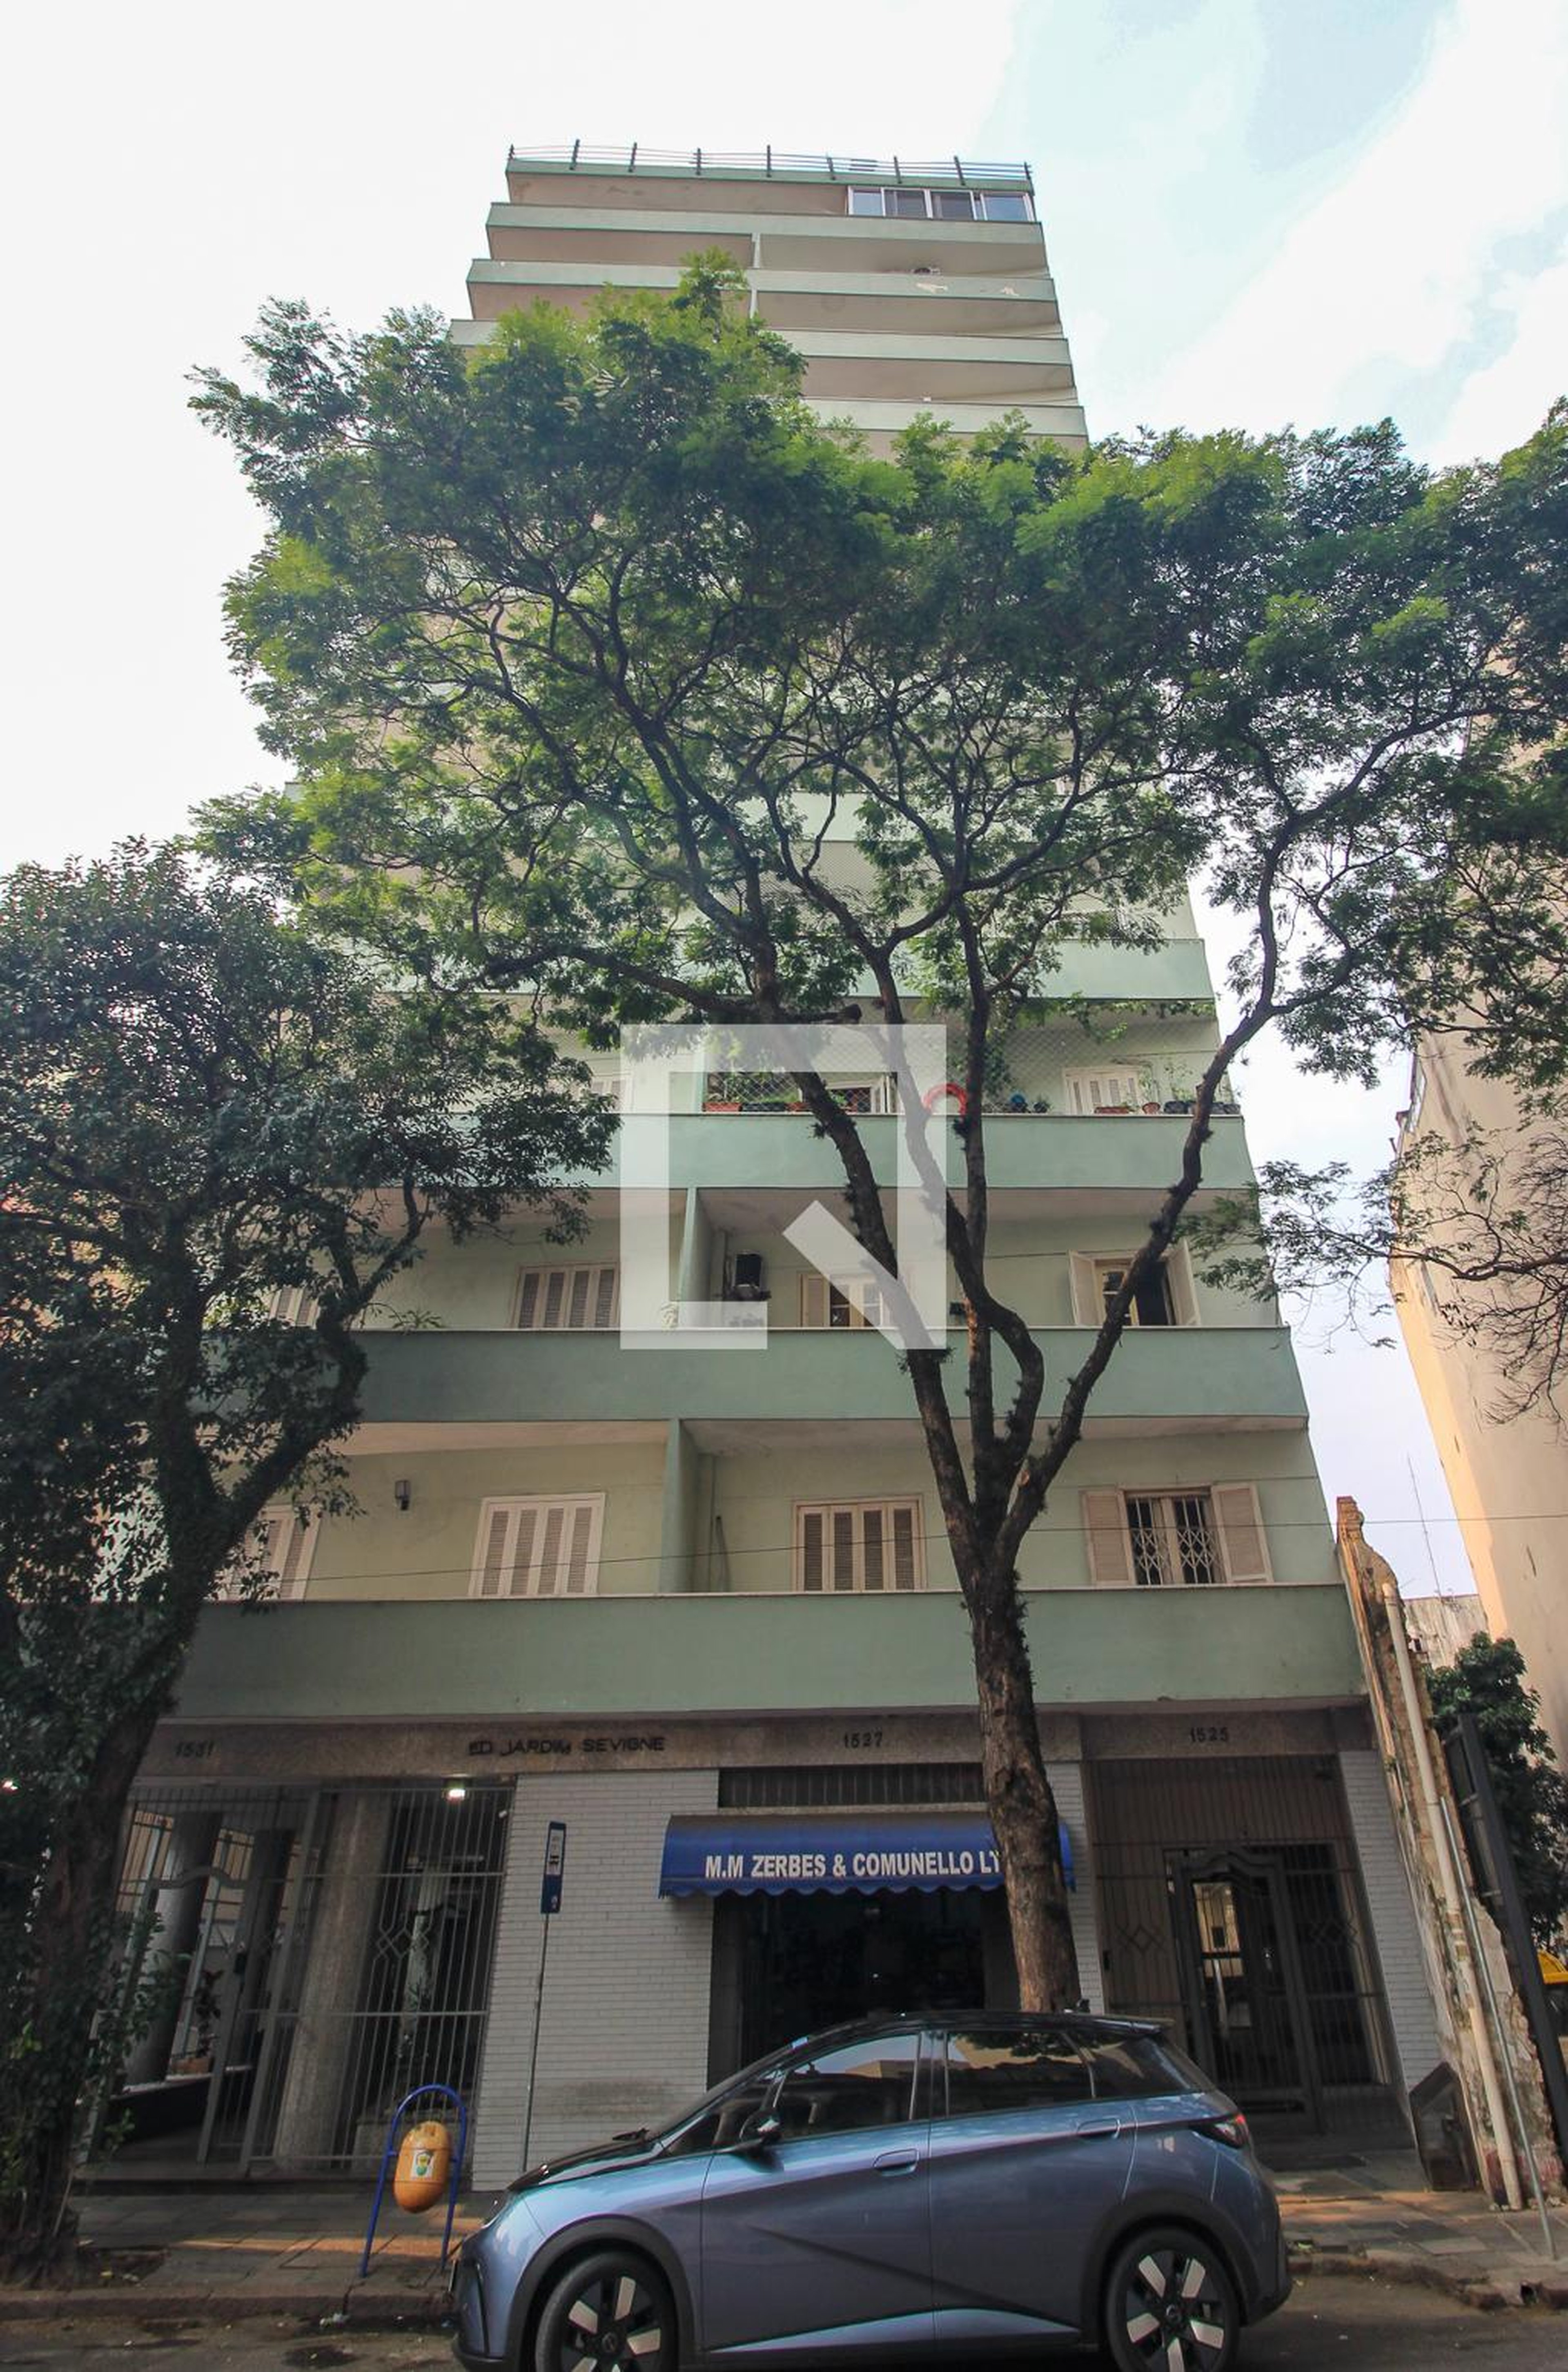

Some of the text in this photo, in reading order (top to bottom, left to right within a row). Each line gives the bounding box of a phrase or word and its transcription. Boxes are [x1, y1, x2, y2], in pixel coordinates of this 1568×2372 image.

[705, 1849, 1000, 1878] M.M ZERBES & COMUNELLO LT
